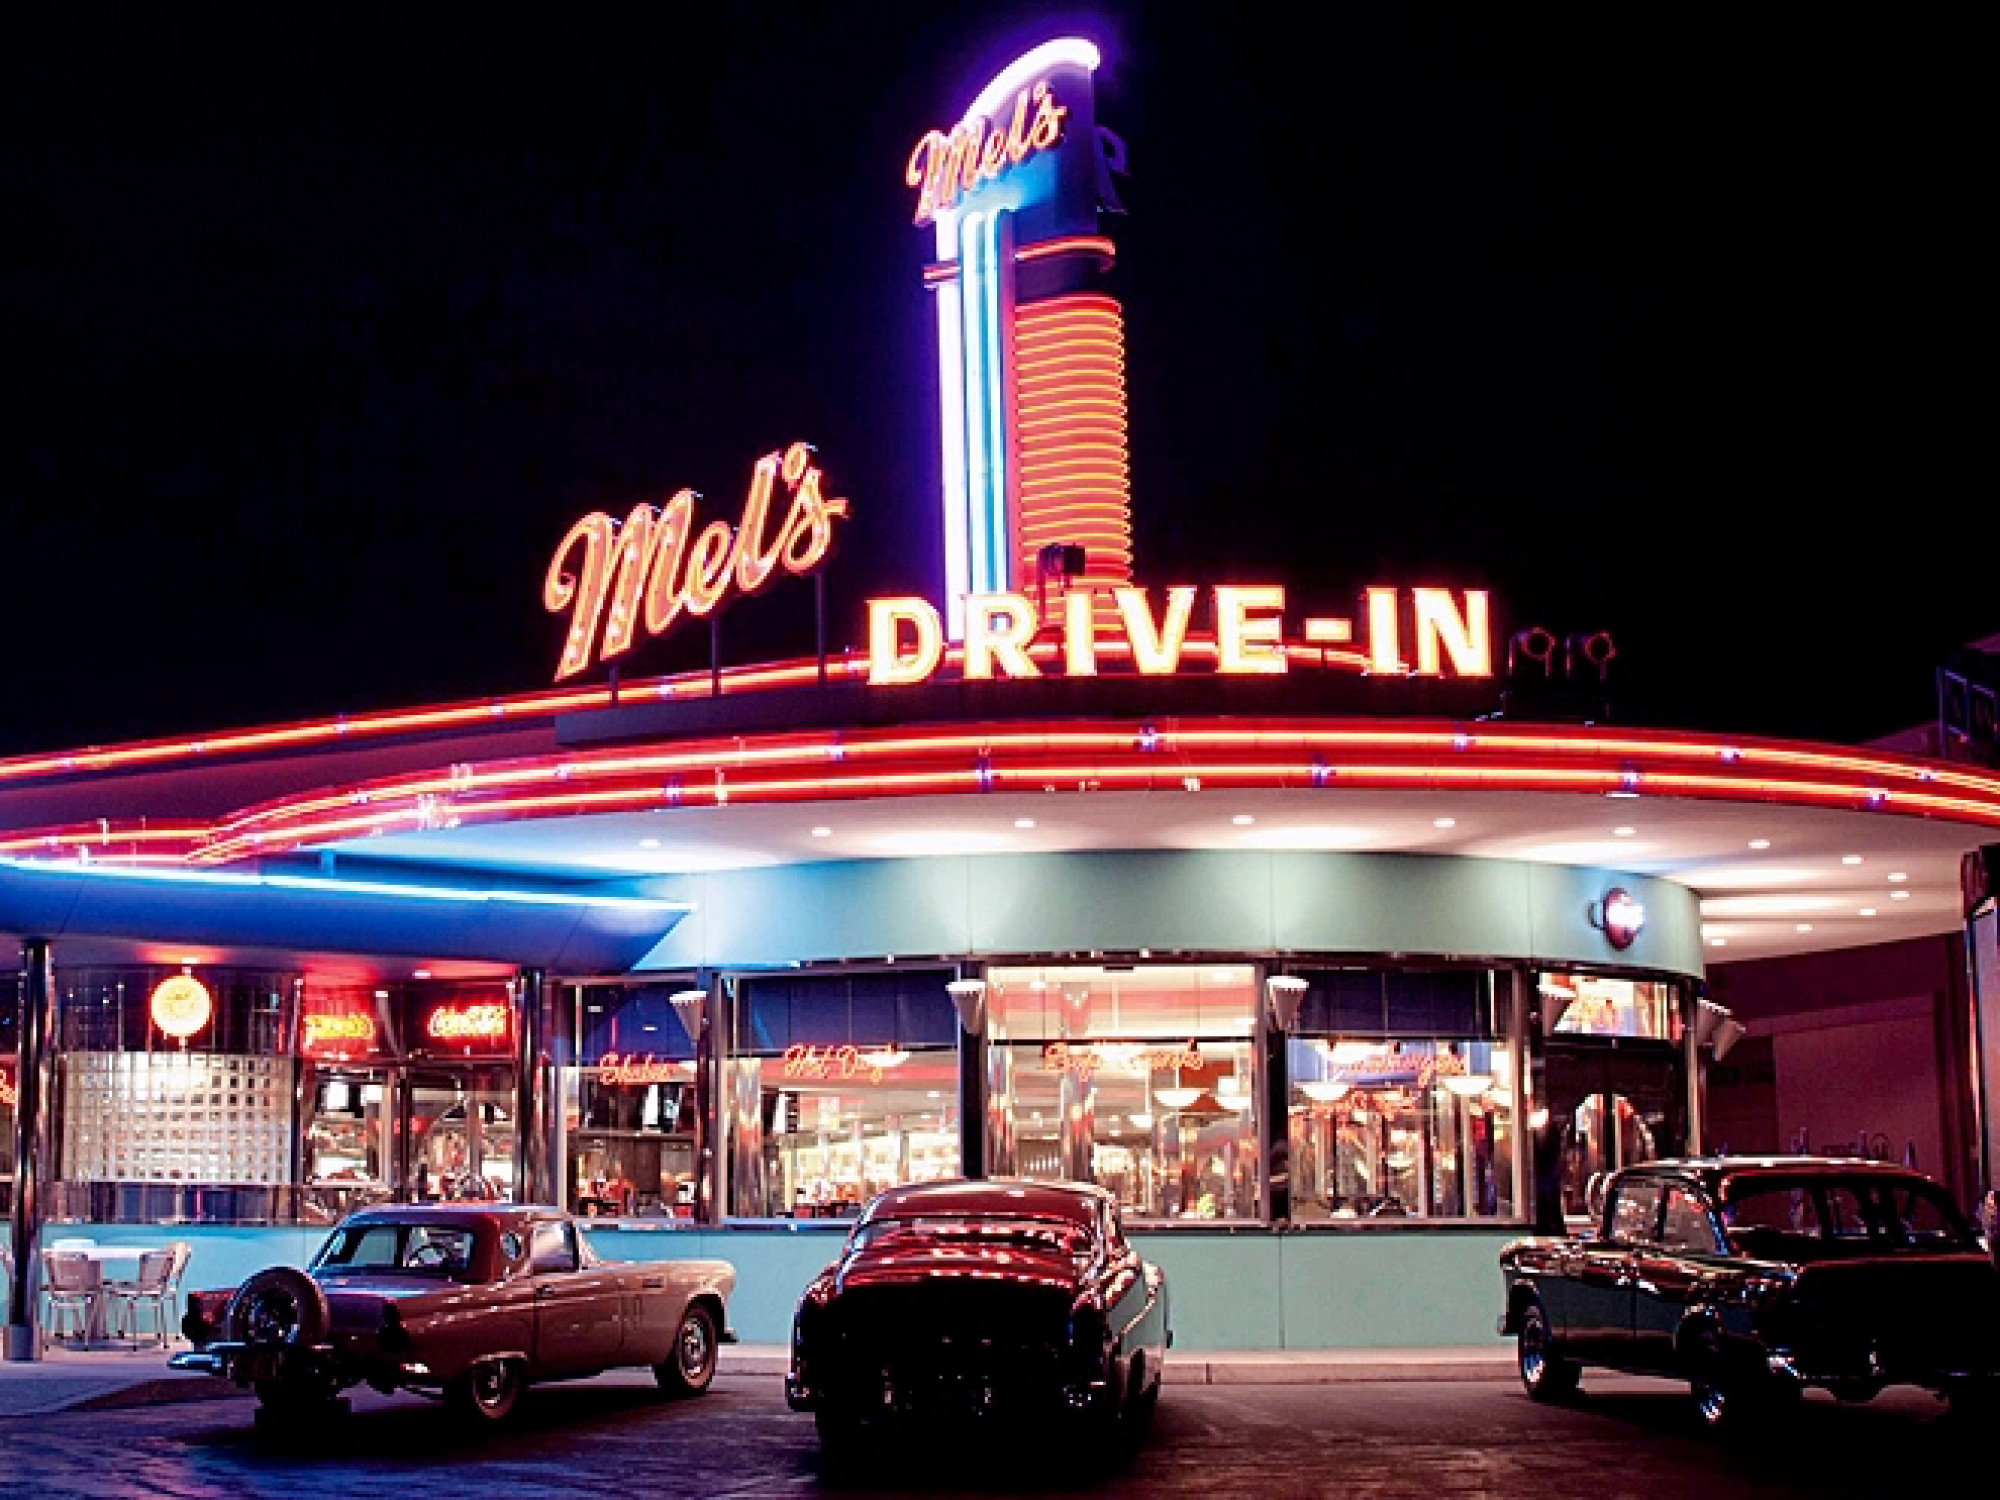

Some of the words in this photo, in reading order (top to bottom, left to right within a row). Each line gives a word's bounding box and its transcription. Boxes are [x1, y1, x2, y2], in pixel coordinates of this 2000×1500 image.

[906, 80, 1067, 226] Mel's
[543, 442, 849, 682] Mel's
[866, 586, 1493, 685] DRIVE-IN
